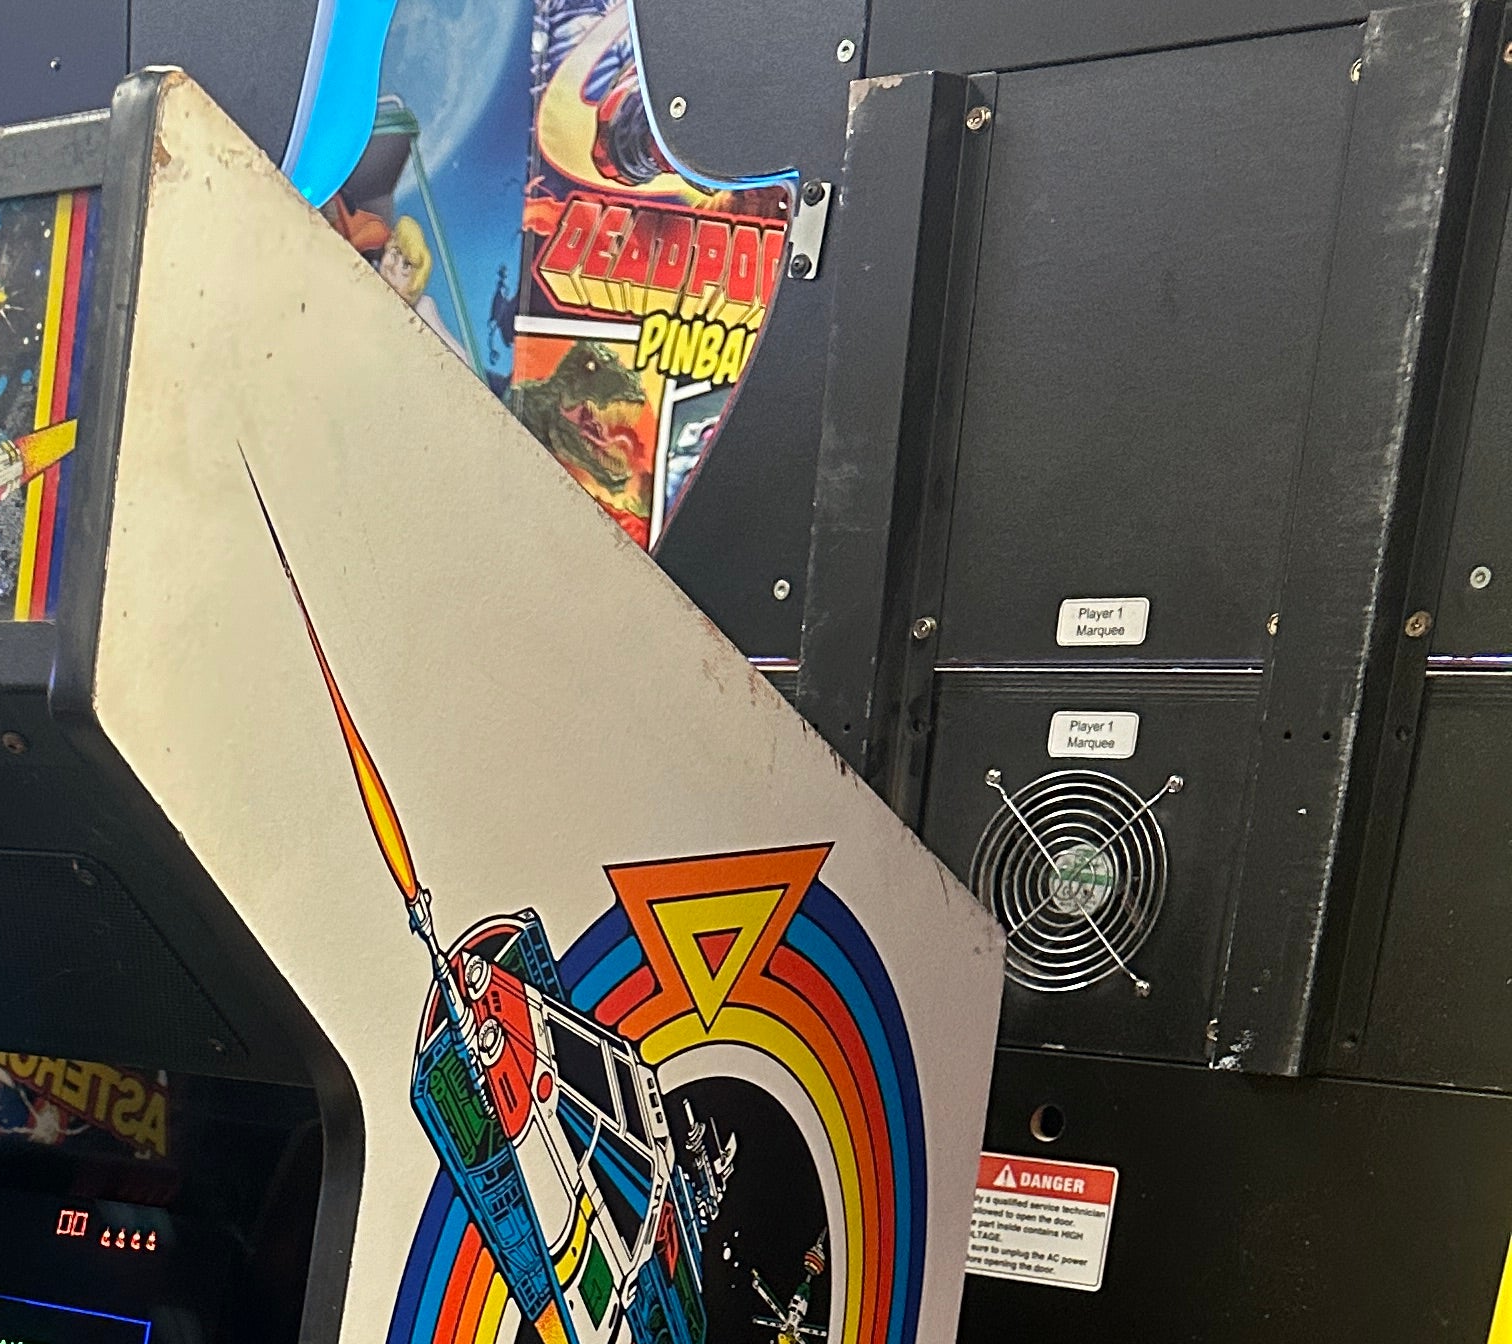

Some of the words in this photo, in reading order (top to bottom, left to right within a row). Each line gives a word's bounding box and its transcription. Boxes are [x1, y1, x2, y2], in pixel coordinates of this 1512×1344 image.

[540, 201, 785, 322] DEADPOO
[636, 313, 756, 385] PINBA
[1079, 608, 1114, 622] Player
[1117, 607, 1124, 619] 1
[1076, 625, 1126, 637] Marquee
[1070, 720, 1105, 734] Player
[1107, 720, 1114, 732] 1
[1067, 736, 1115, 750] Marquee
[1020, 1171, 1086, 1194] DANGER
[993, 1196, 1028, 1209] qualified
[1030, 1201, 1060, 1212] service
[1063, 1205, 1106, 1218] technician
[1006, 1210, 1014, 1219] to
[1016, 1212, 1037, 1222] open
[1039, 1213, 1052, 1224] the
[1054, 1217, 1075, 1227] door.
[970, 1230, 1002, 1242] LTAGE.
[979, 1220, 996, 1230] part
[997, 1221, 1021, 1232] inside
[1023, 1226, 1059, 1237] contains
[1062, 1229, 1084, 1240] HIGH
[971, 1244, 989, 1253] sure
[991, 1245, 1000, 1254] to
[1001, 1248, 1030, 1259] unplug
[1032, 1250, 1045, 1260] the
[1047, 1253, 1060, 1262] AC
[1062, 1255, 1088, 1266] power
[984, 1257, 1017, 1269] opening
[1019, 1261, 1032, 1271] the
[1033, 1263, 1056, 1275] door.
